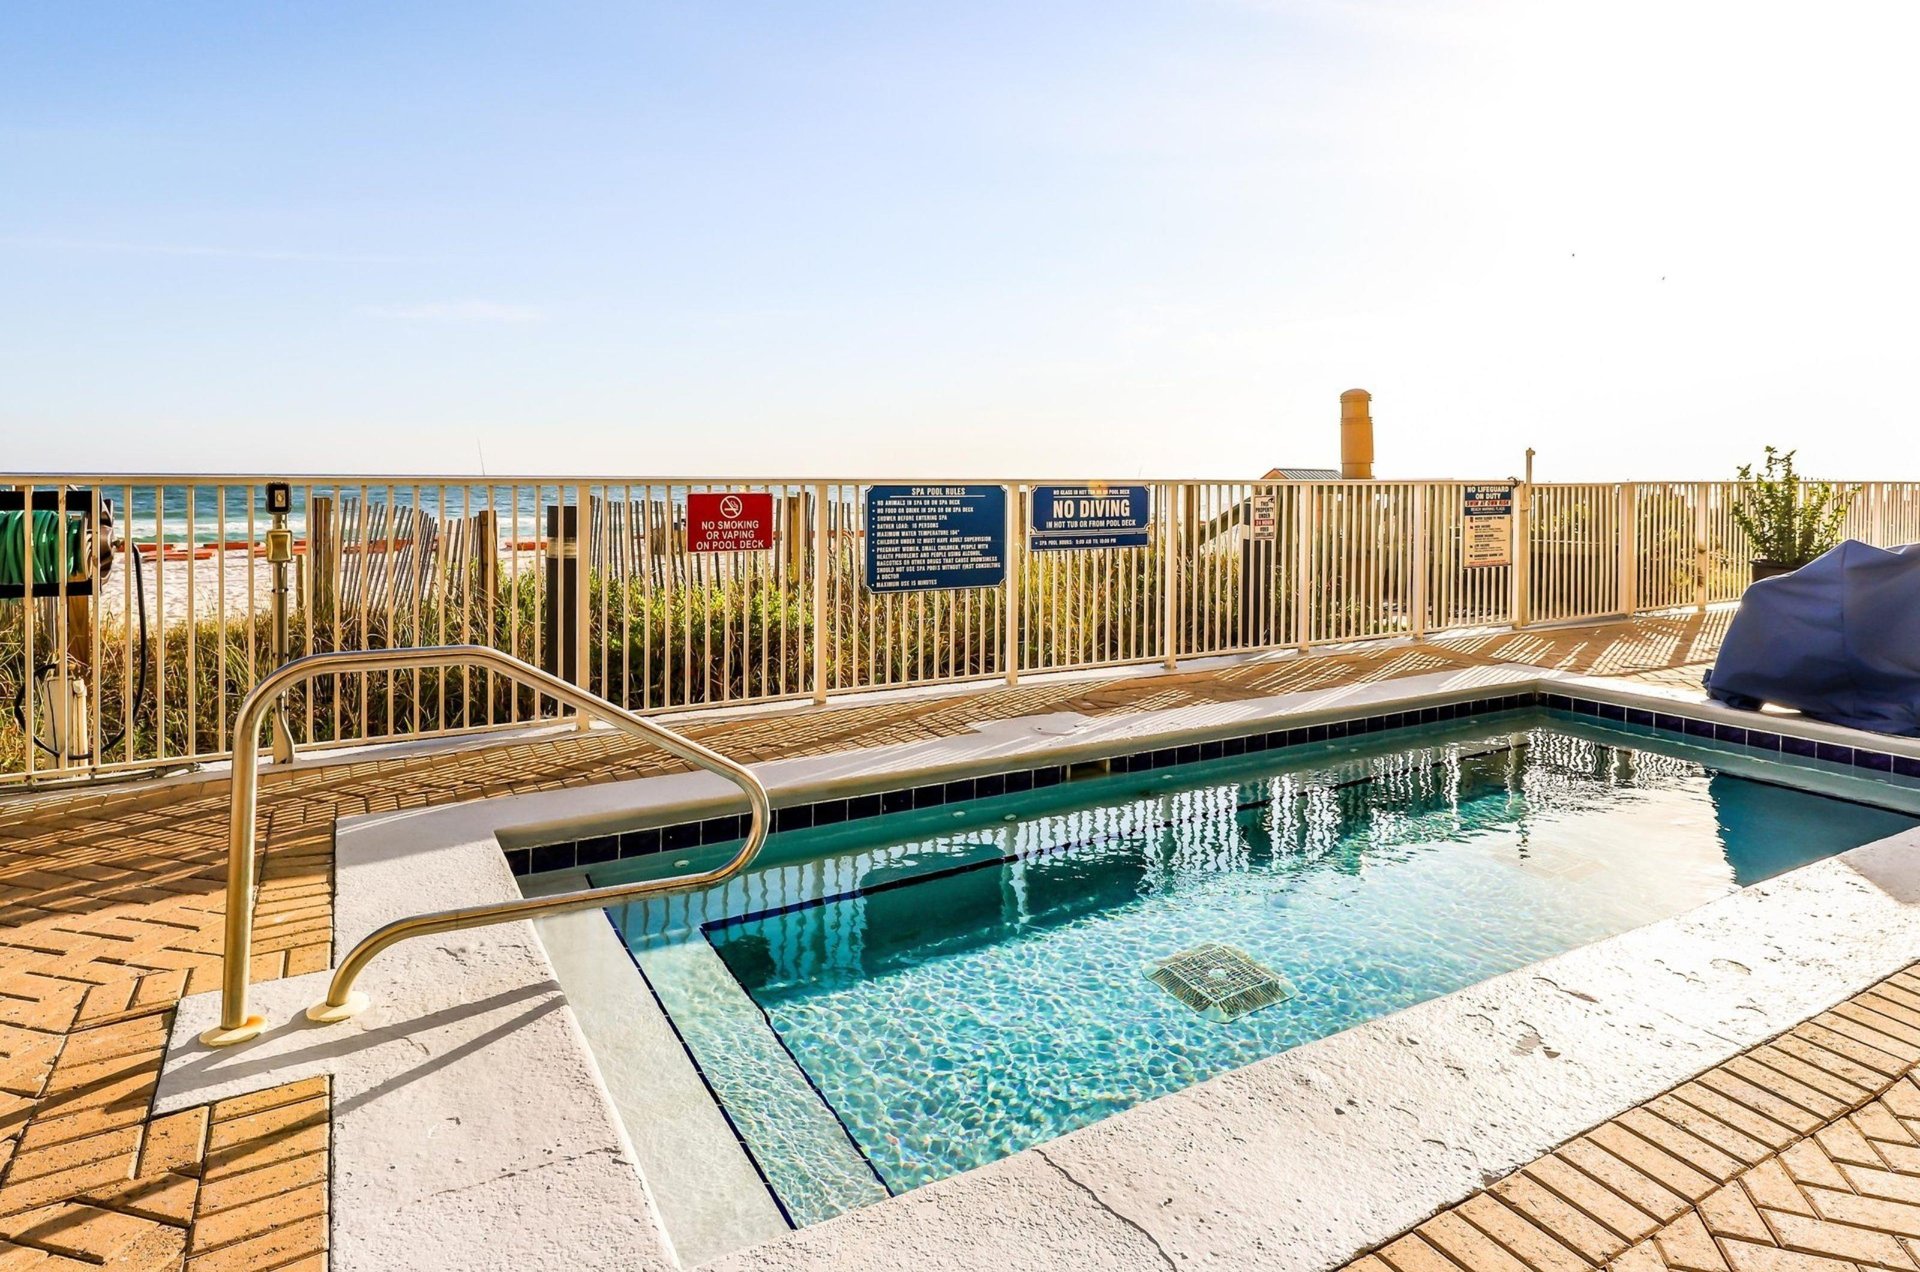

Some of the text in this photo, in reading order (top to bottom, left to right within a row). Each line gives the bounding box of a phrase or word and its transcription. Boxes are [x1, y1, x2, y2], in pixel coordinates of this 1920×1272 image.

[912, 488, 966, 496] SPA POOL RULES
[1053, 499, 1130, 518] NO DIVING
[702, 520, 758, 530] NO SMOKING
[706, 530, 754, 539] OR VAPING
[696, 540, 764, 550] ON POOL DECK
